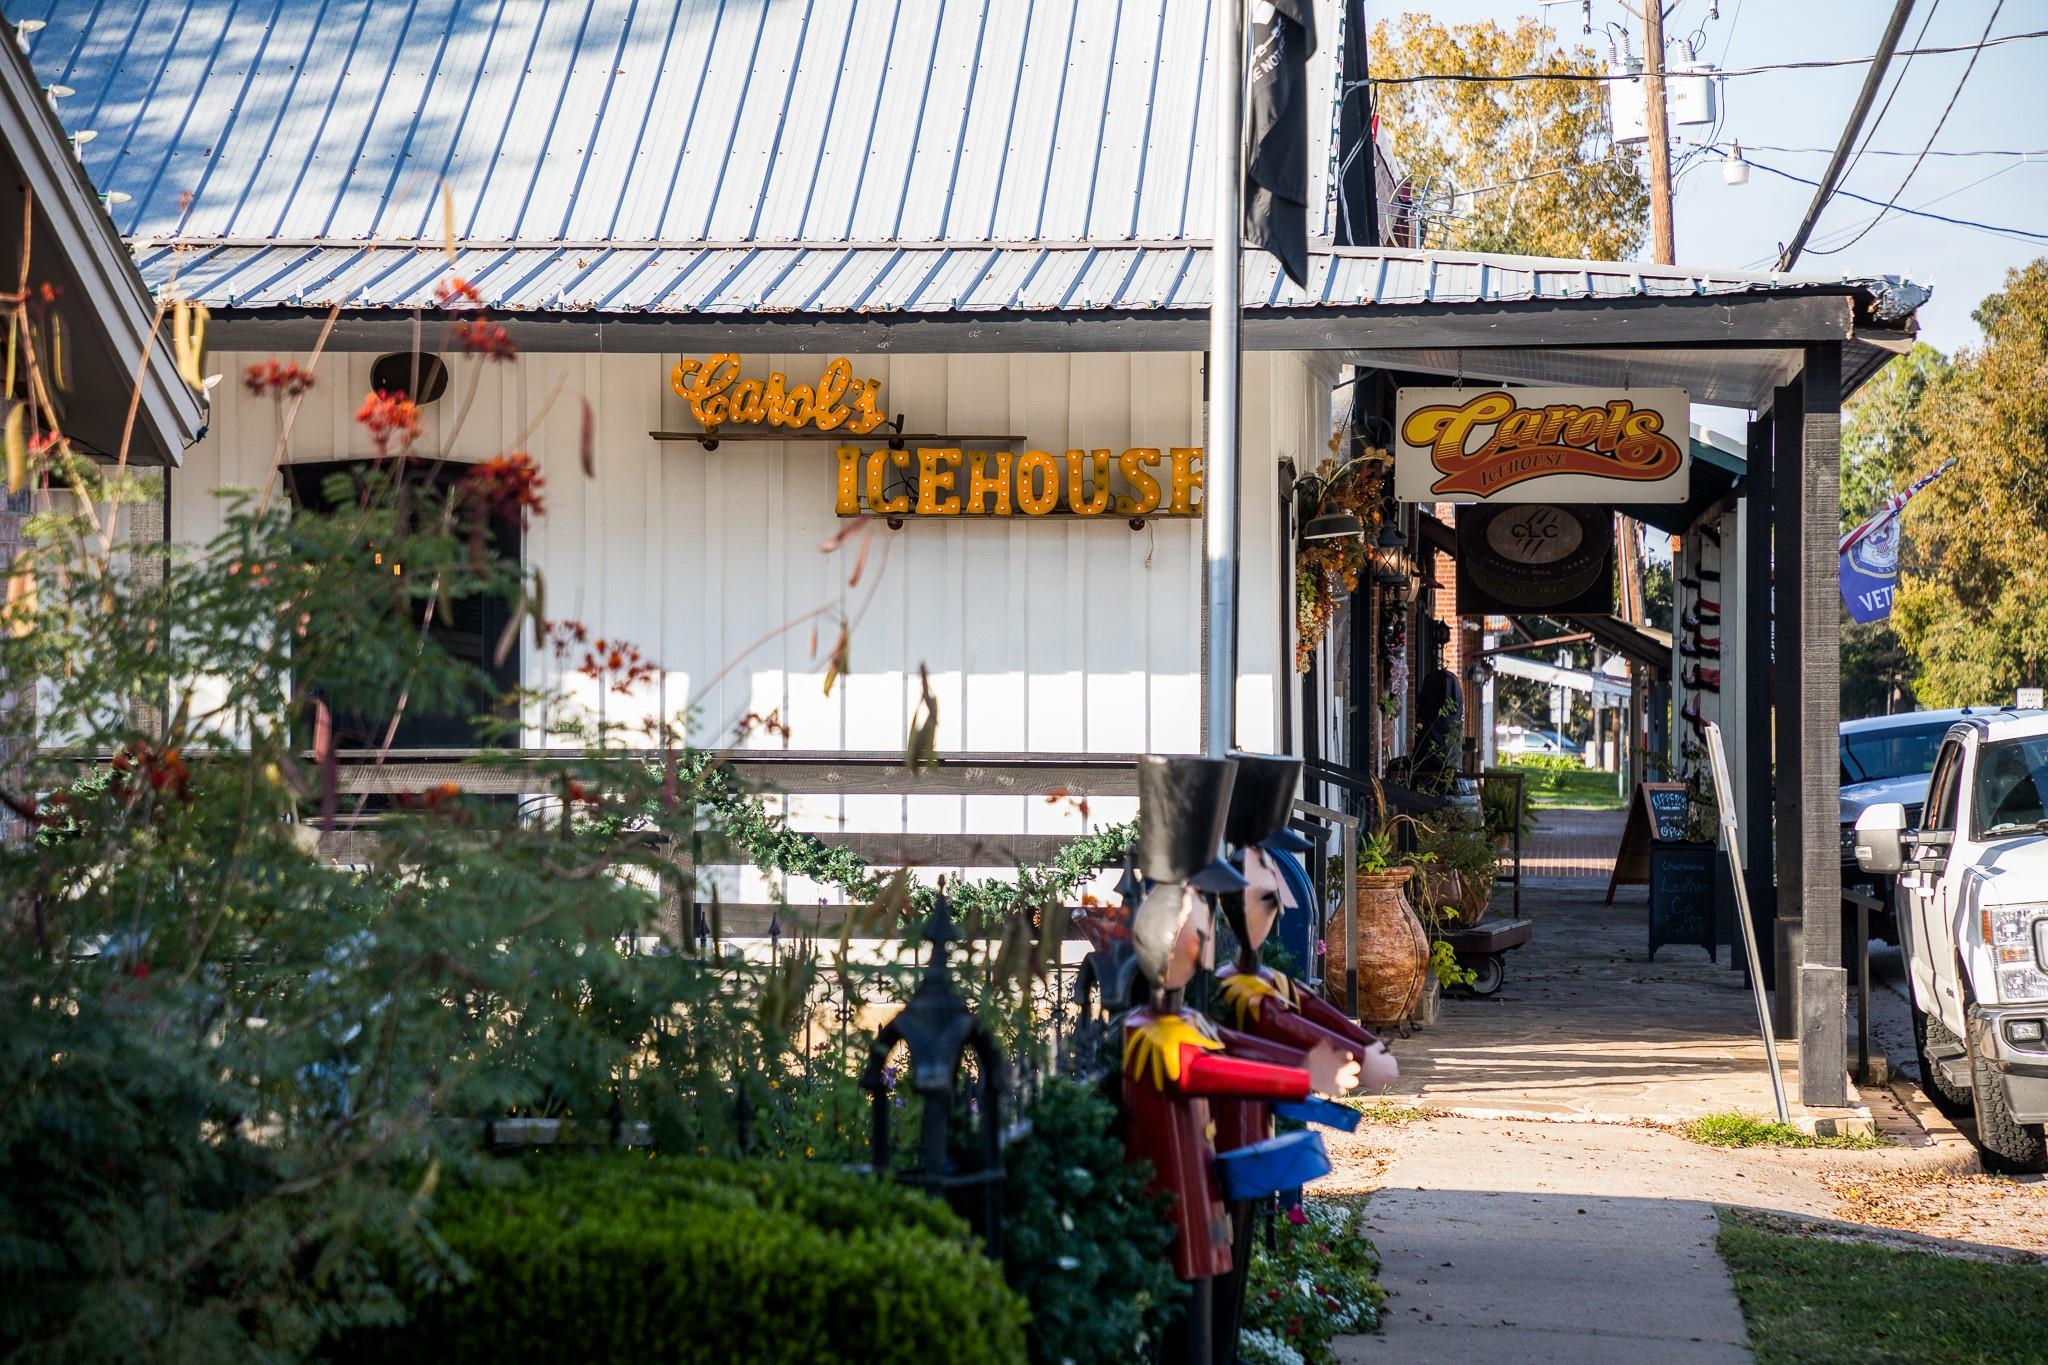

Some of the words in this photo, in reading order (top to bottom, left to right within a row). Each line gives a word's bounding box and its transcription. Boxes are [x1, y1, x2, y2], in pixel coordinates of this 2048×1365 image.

[671, 352, 886, 434] Carol's
[1403, 392, 1670, 474] Carols
[836, 447, 1203, 515] ICEHOUSE
[1480, 453, 1566, 486] ICEHOUSE
[1512, 524, 1558, 538] CLC
